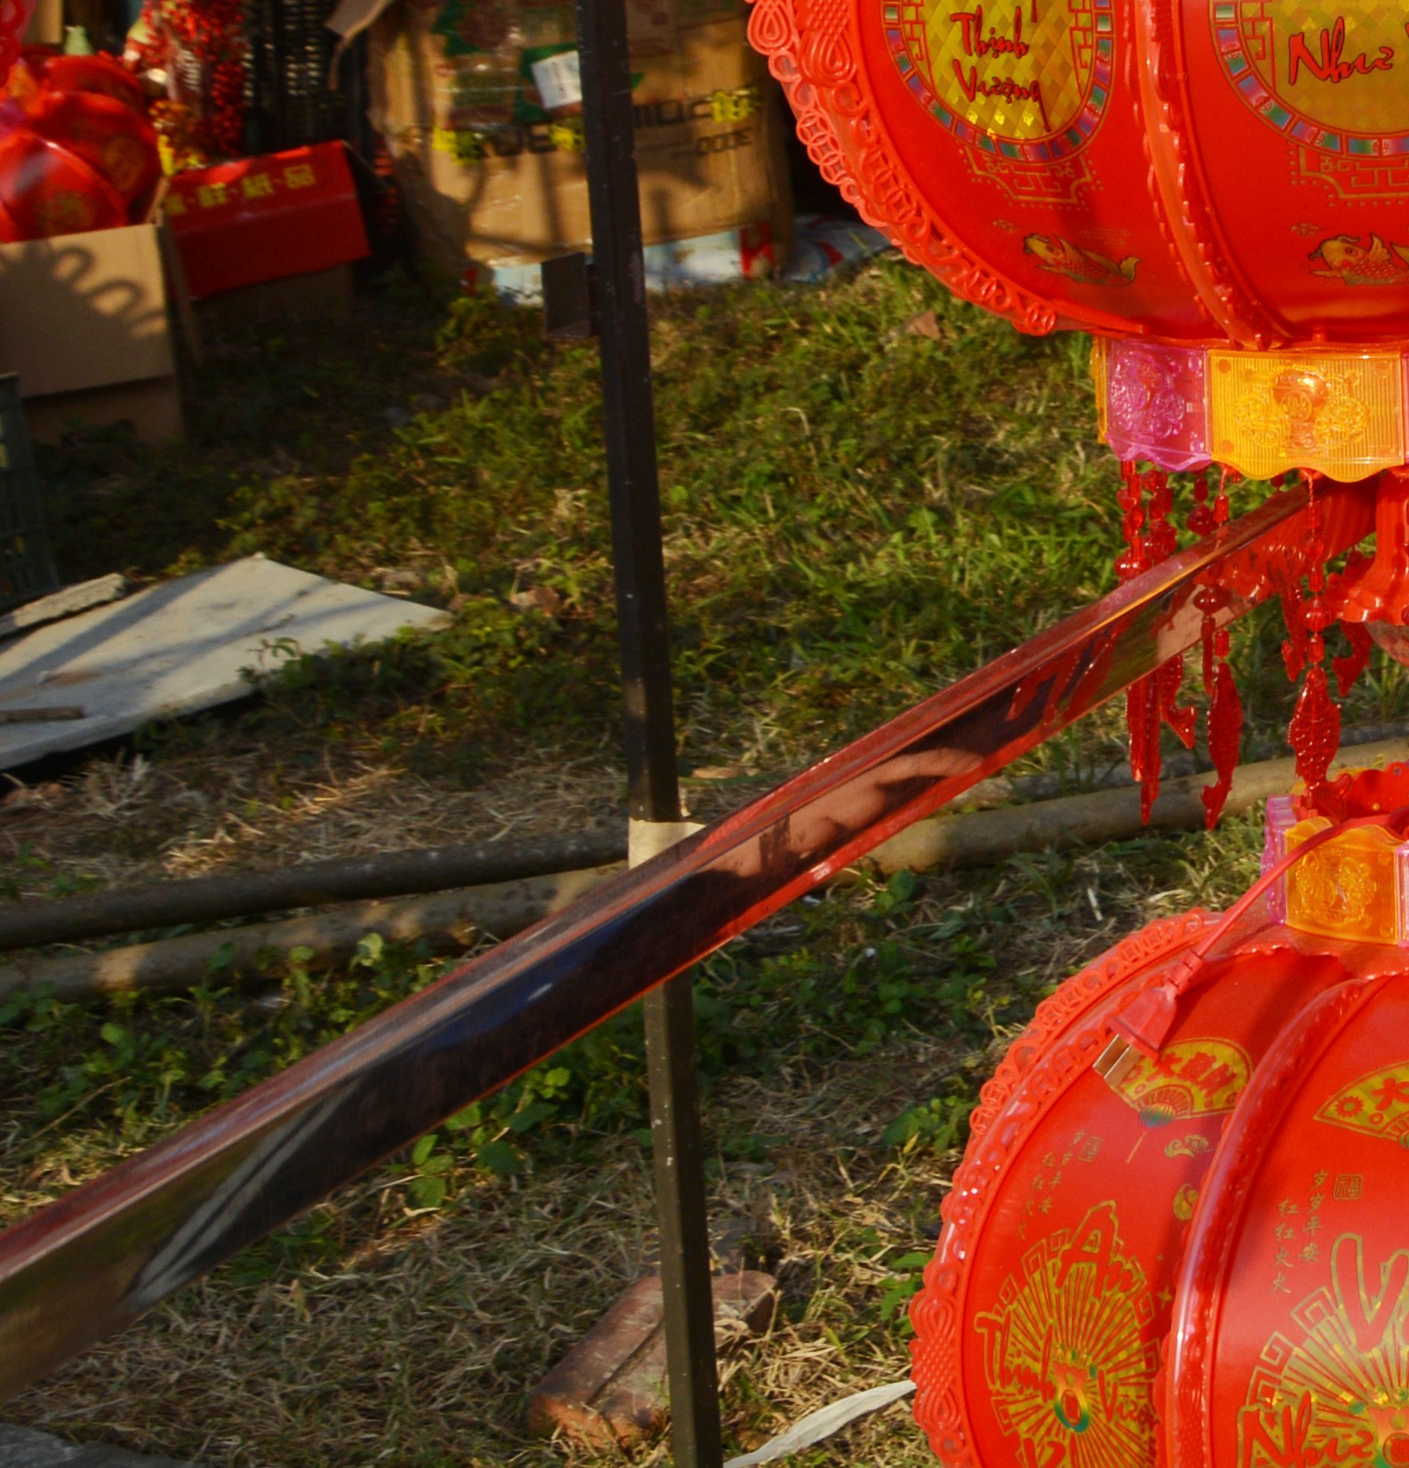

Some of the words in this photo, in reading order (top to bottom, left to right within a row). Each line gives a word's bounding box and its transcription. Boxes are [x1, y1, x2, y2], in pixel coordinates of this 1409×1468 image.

[951, 5, 1030, 58] Thịnh
[1289, 16, 1394, 85] Như
[953, 59, 1052, 132] Vượng
